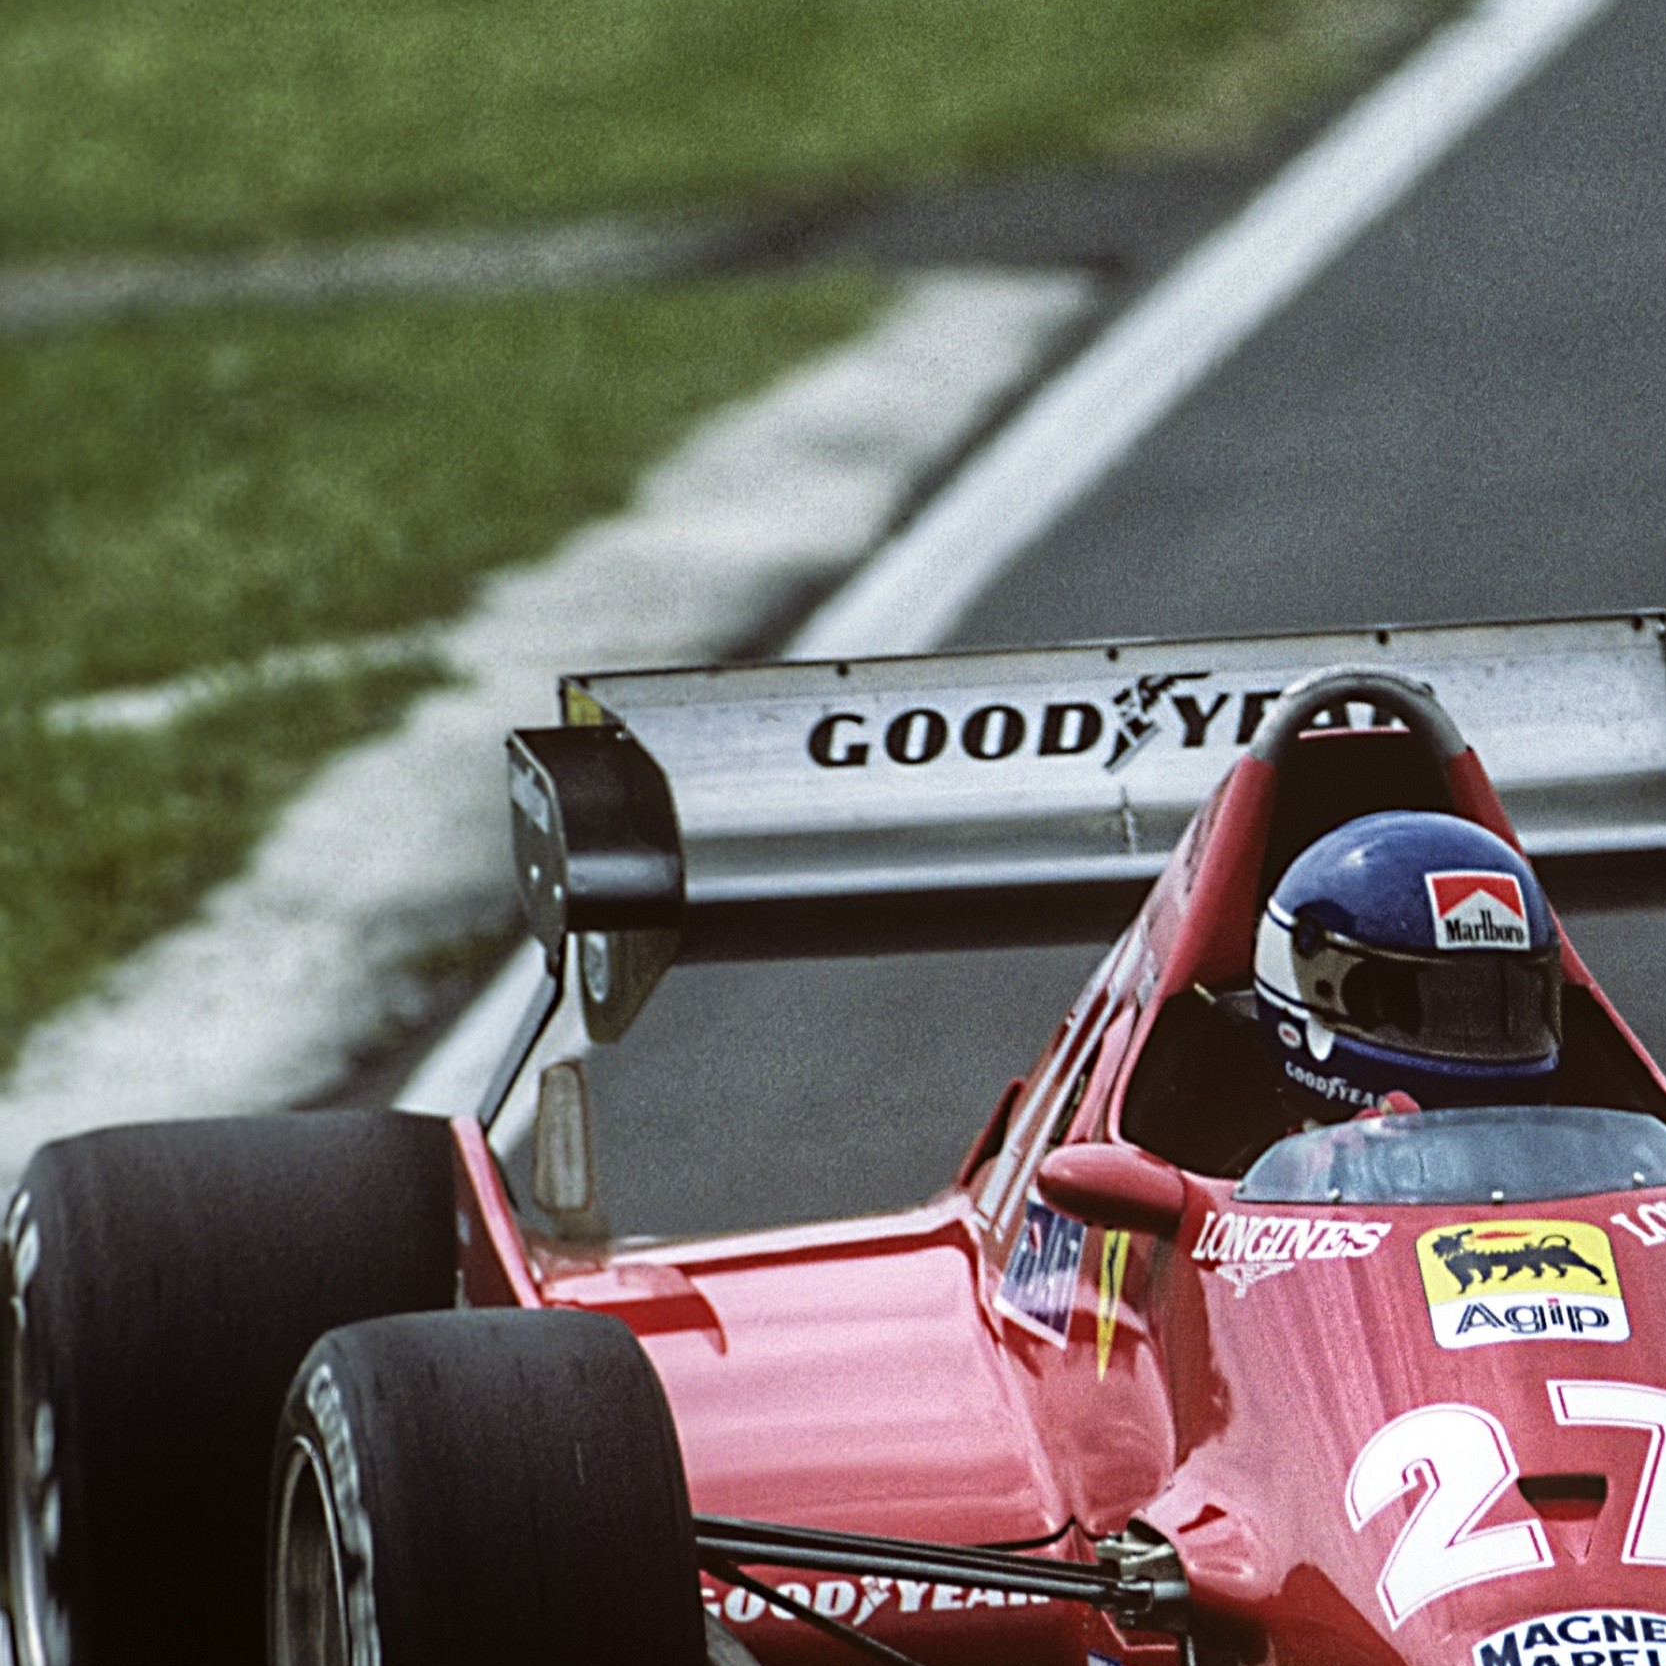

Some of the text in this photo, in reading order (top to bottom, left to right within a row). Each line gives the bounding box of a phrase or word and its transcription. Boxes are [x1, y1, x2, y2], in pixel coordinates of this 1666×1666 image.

[1446, 909, 1525, 944] Marlboro
[1191, 1210, 1393, 1261] LONGINES
[1455, 1297, 1610, 1336] Agip
